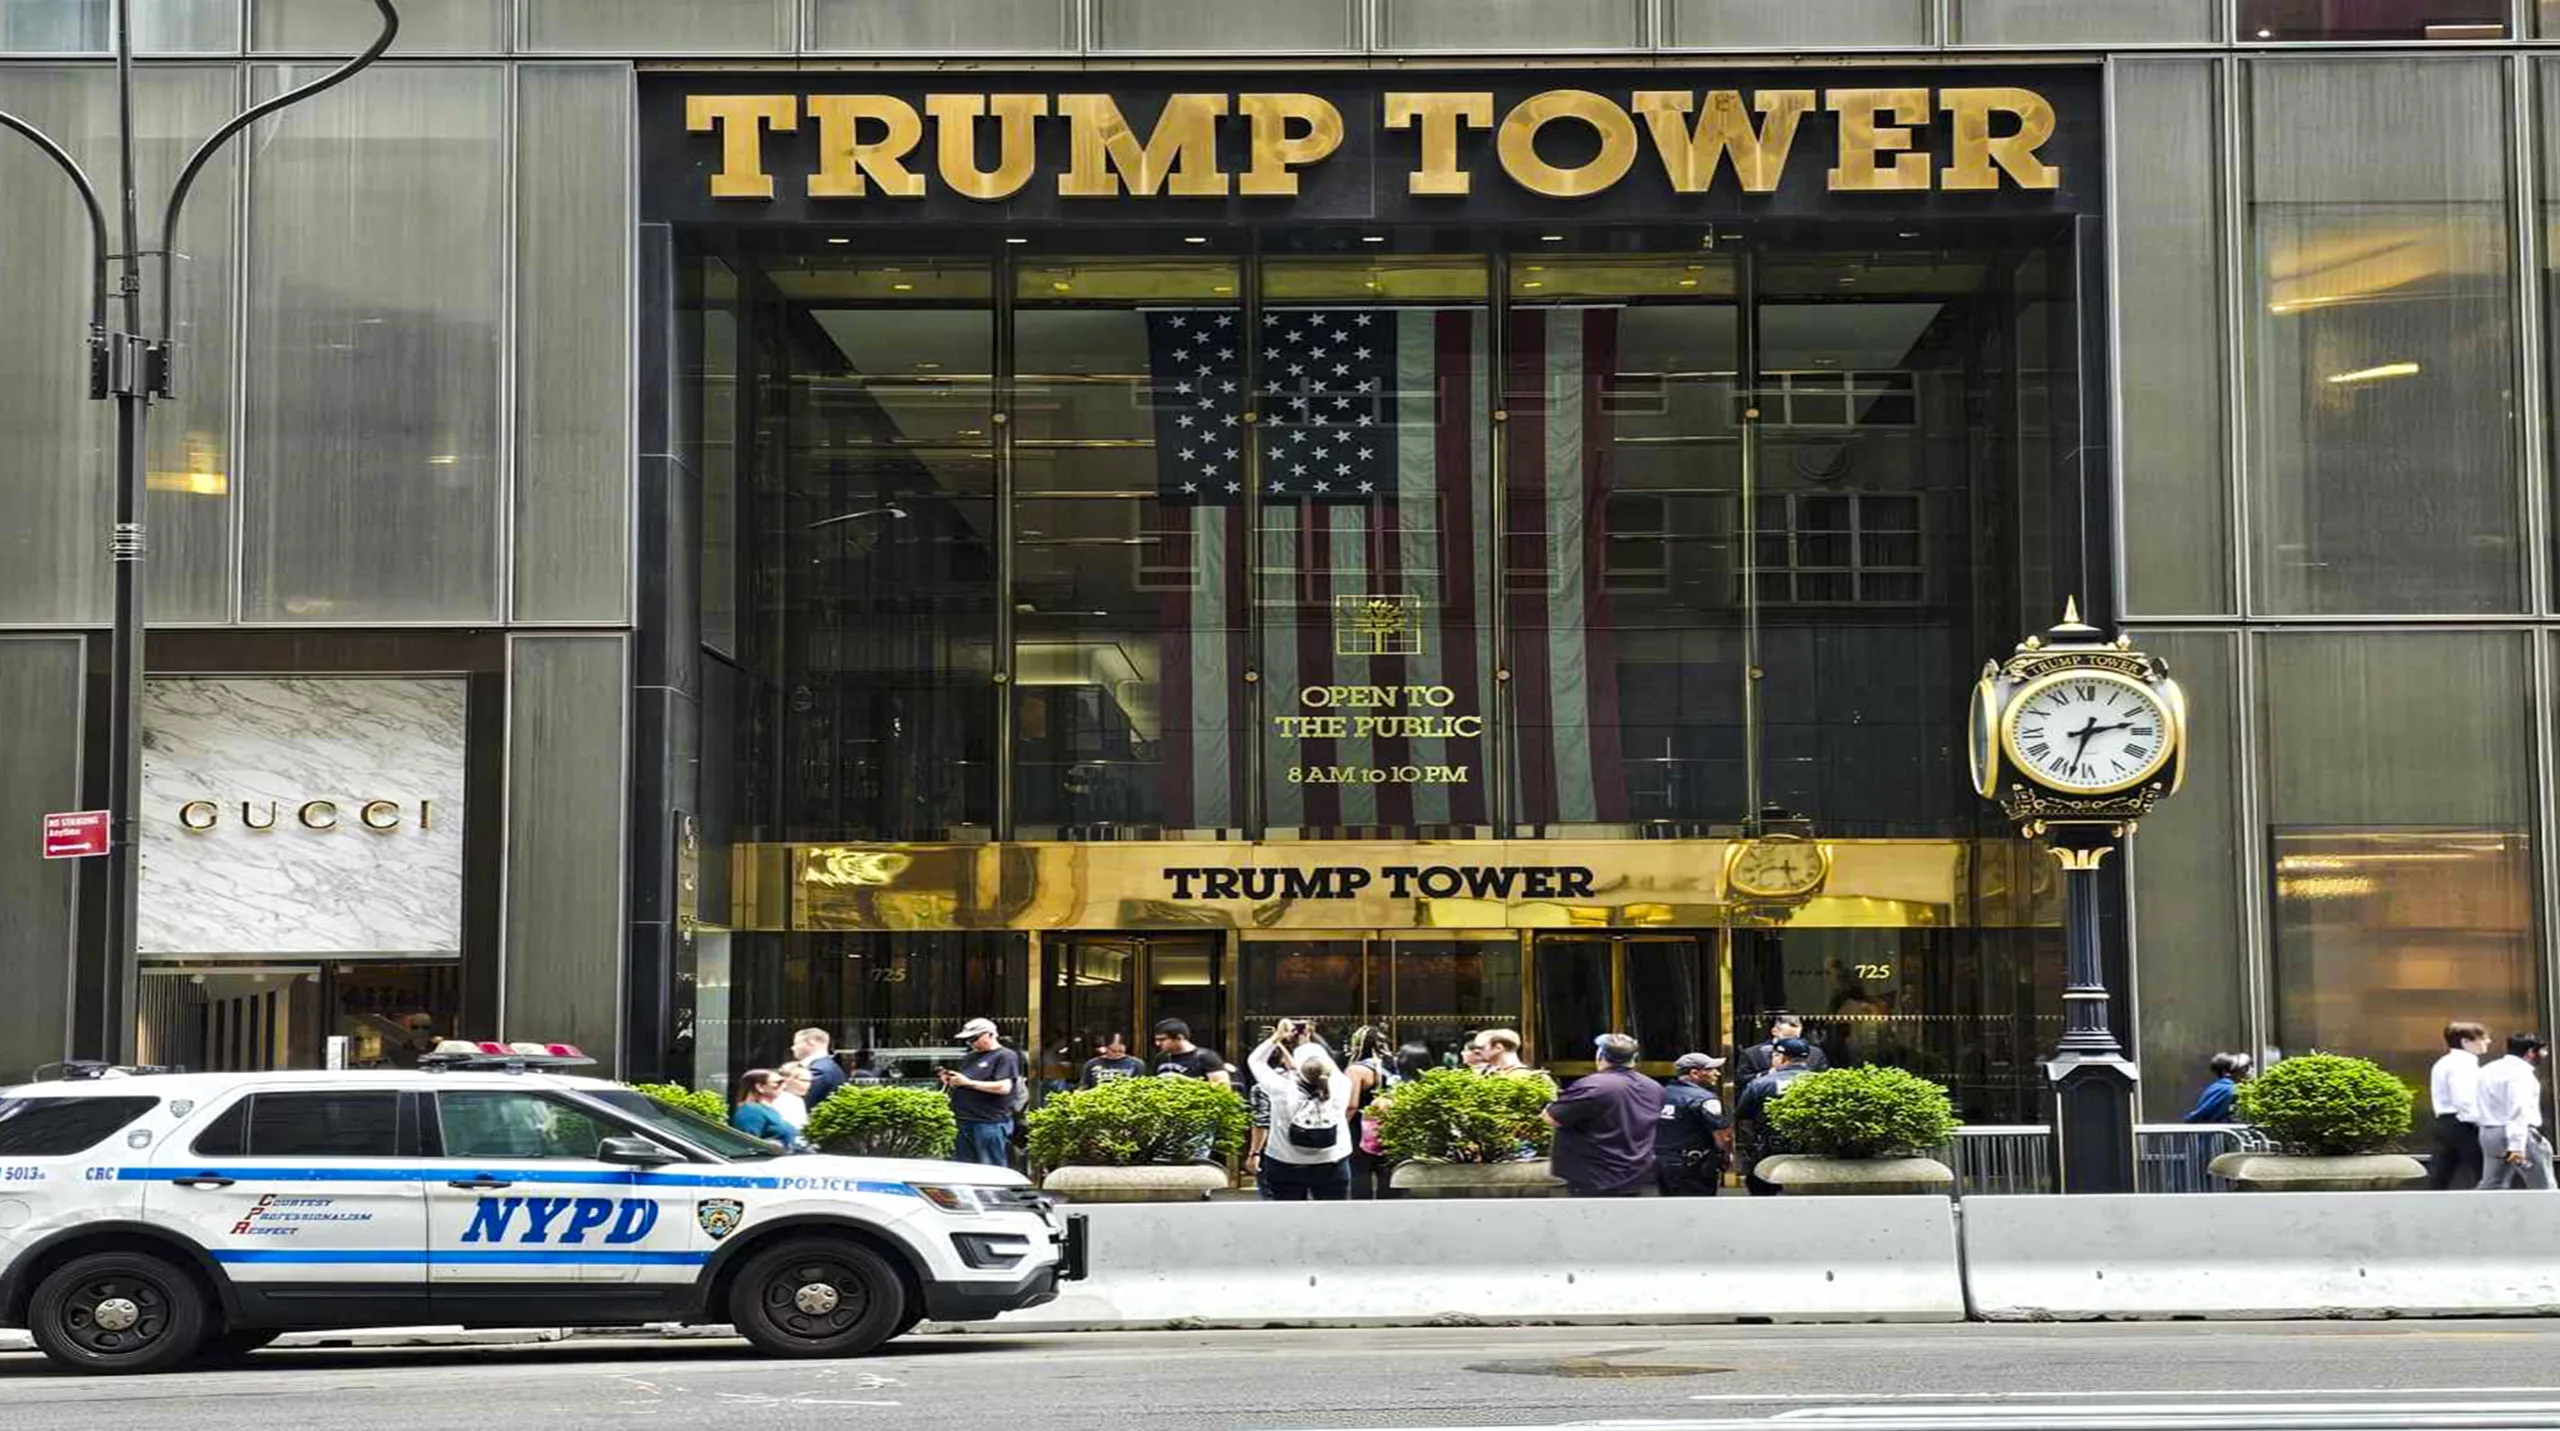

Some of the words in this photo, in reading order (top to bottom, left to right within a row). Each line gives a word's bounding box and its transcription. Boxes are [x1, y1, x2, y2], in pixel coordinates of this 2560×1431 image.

[686, 93, 1344, 199] TRUMP
[1384, 87, 2060, 197] TOWER
[2029, 656, 2081, 675] TRUMP
[2088, 656, 2140, 674] TOWER
[1301, 686, 1398, 707] OPEN
[1404, 686, 1454, 707] TO
[1275, 717, 1346, 737] THE
[1354, 716, 1482, 738] PUBLIC
[1288, 767, 1302, 783] 8
[1304, 766, 1356, 783] AM
[1361, 768, 1387, 783] to
[1391, 767, 1421, 783] 10
[1425, 766, 1468, 783] PM
[179, 800, 430, 830] GUCCI
[1163, 867, 1371, 900] TRUMP
[1382, 866, 1594, 899] TOWER
[871, 968, 906, 982] 725
[1854, 964, 1891, 979] 725
[5, 1167, 39, 1180] 5013
[85, 1167, 115, 1180] CRC
[782, 1176, 857, 1192] POLICE
[461, 1197, 659, 1243] NYPD
